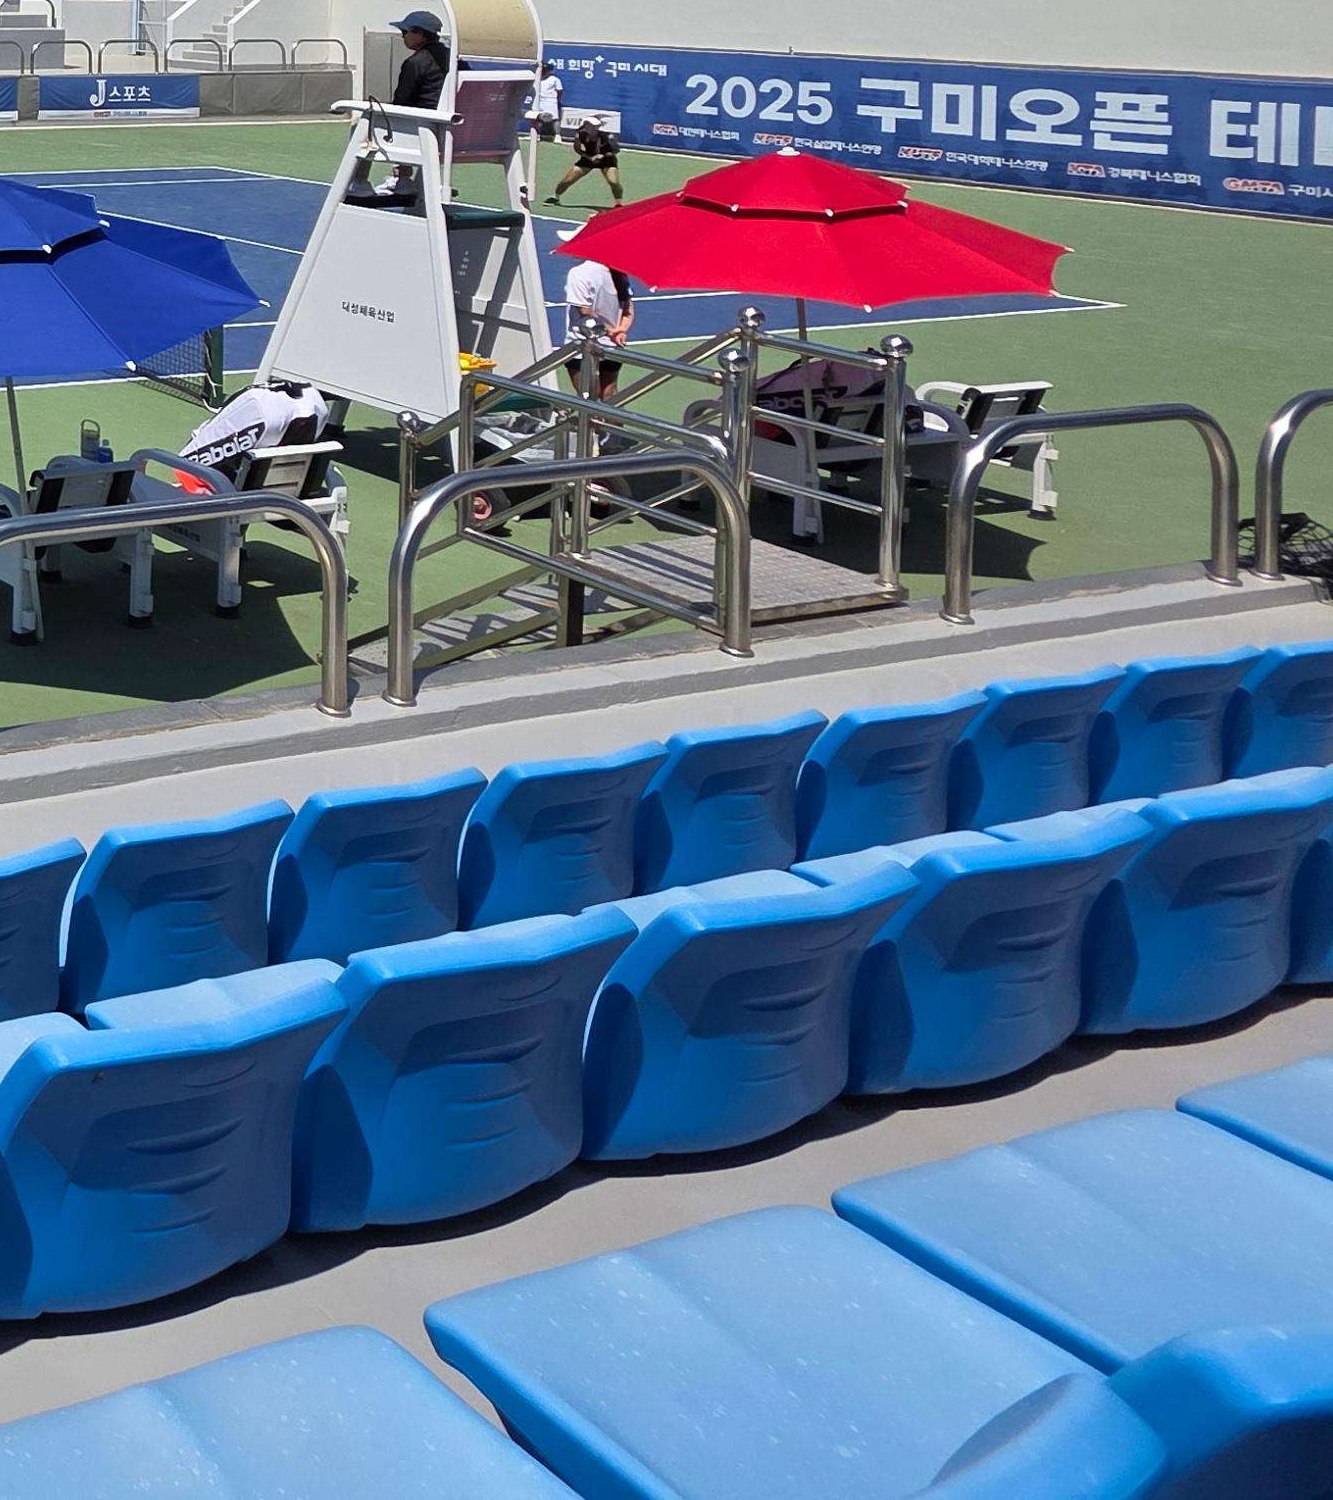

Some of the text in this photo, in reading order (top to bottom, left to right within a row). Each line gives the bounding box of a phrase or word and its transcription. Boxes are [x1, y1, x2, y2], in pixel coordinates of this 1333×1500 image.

[568, 59, 595, 79] 희망
[634, 63, 667, 77] 시대
[685, 74, 833, 125] 2025
[856, 77, 1173, 155] 구미오픈
[342, 301, 395, 323] 대성체육산업
